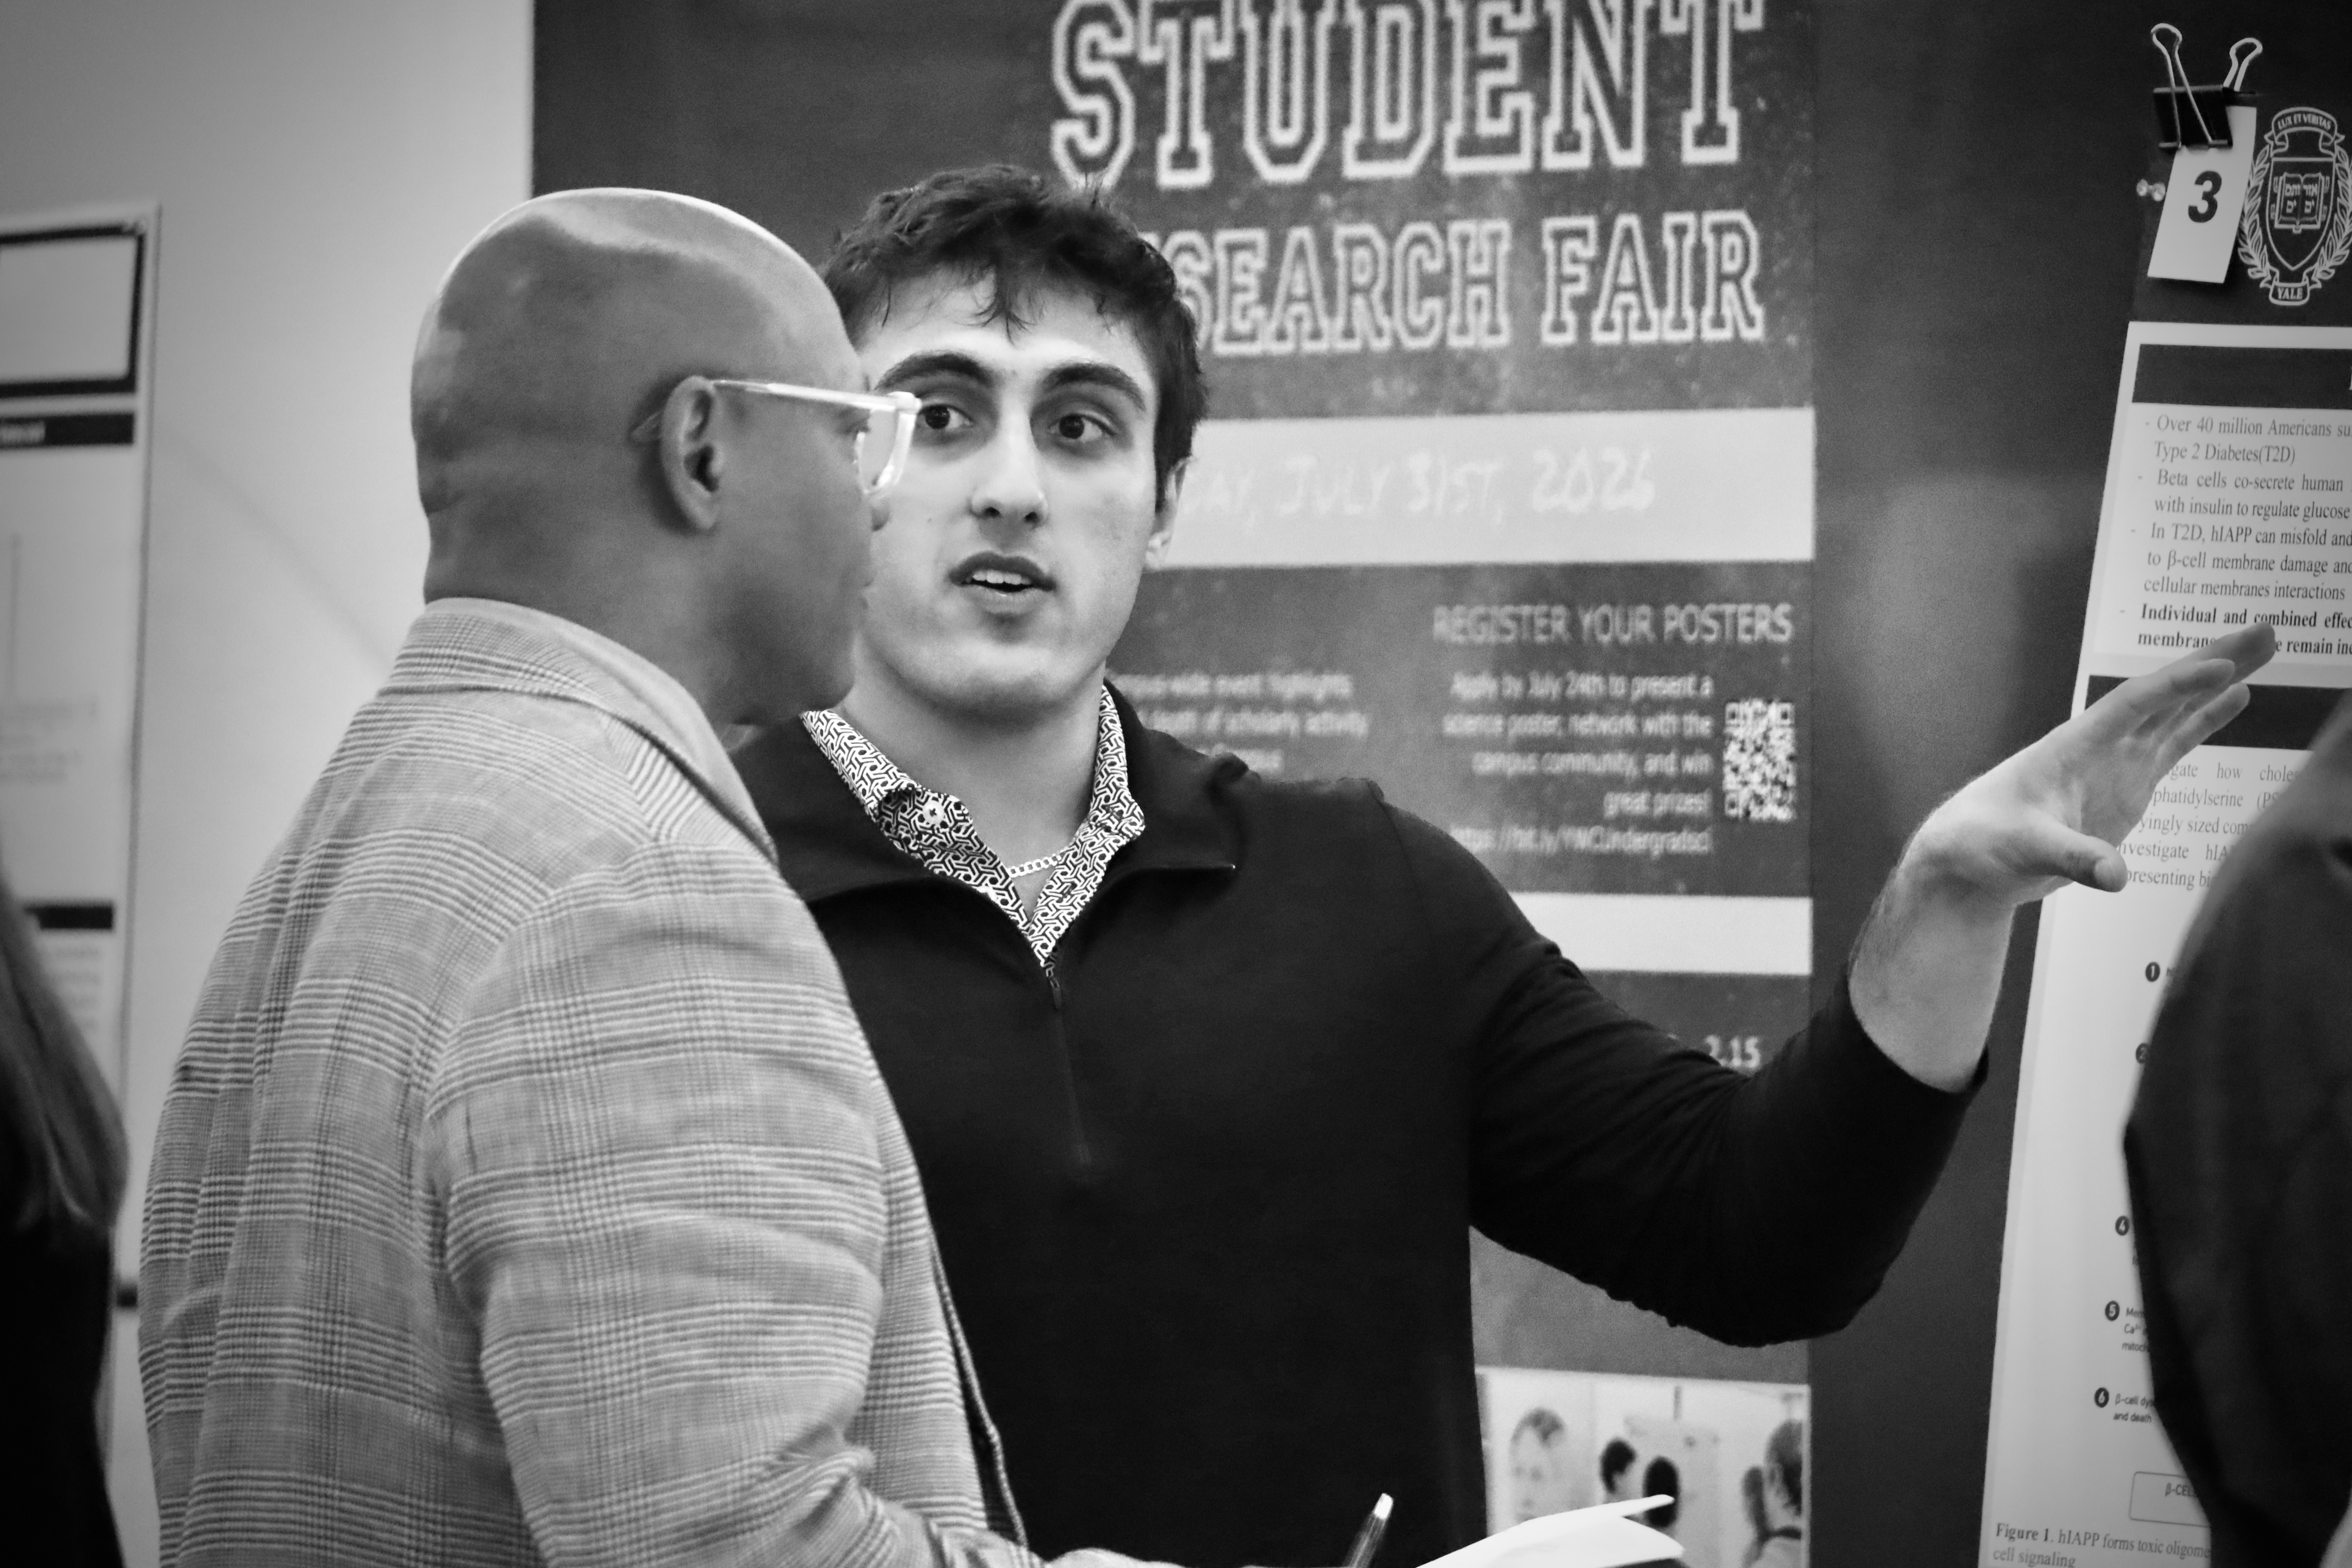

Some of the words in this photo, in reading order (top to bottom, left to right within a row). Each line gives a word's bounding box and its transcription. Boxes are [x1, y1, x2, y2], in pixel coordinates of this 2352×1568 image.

[1050, 0, 1764, 188] STUDENT
[2278, 116, 2292, 130] LUX
[2293, 114, 2301, 124] ET
[2303, 114, 2331, 130] VERITAS
[2188, 170, 2222, 223] 3
[1153, 219, 1509, 356] SEARCH
[1541, 210, 1765, 345] FAIR
[2278, 287, 2303, 300] YALE
[2157, 414, 2191, 433] Over
[2196, 416, 2214, 433] 40
[2218, 417, 2263, 435] million
[2267, 419, 2332, 437] Americans
[2154, 440, 2188, 464] Type
[2191, 443, 2200, 459] 2
[2204, 443, 2295, 466] Diabetes(T2D)
[1278, 452, 1393, 516] JULY
[1530, 444, 1656, 514] 2026
[2157, 468, 2188, 487] Beta
[2196, 470, 2227, 488] cells
[2234, 475, 2295, 490] co-secrete
[2301, 474, 2343, 492] human
[2154, 495, 2185, 513] with
[2190, 496, 2233, 515] insulin
[2237, 501, 2249, 516] to
[2252, 501, 2300, 522] regulate
[2303, 501, 2350, 522] glucose
[2151, 522, 2165, 539] In
[2172, 523, 2205, 544] T2D,
[2211, 525, 2252, 544] hIAPP
[2255, 531, 2275, 544] can
[2280, 527, 2327, 546] misfold
[2148, 551, 2161, 566] to
[2212, 553, 2275, 571] membrane
[2280, 555, 2328, 577] damage
[2144, 576, 2197, 594] cellular
[2201, 579, 2270, 597] membranes
[2274, 580, 2346, 601] interactions
[1433, 603, 1570, 643] REGISTER
[1580, 603, 1655, 643] YOUR
[1663, 602, 1792, 643] POSTERS
[2141, 603, 2217, 623] Individual
[2223, 608, 2248, 625] and
[2254, 609, 2317, 628] combined
[2286, 638, 2333, 654] remain
[1528, 671, 1562, 701] July
[1565, 671, 1606, 698] 24th
[1608, 675, 1628, 697] to
[1630, 675, 1697, 705] present
[1699, 676, 1714, 698] a
[1568, 711, 1637, 737] network
[1642, 710, 1681, 738] with
[1683, 710, 1713, 739] the
[1644, 749, 1678, 776] and
[1682, 750, 1713, 776] win
[2216, 761, 2243, 779] how
[1603, 791, 1651, 820] great
[2187, 815, 2219, 833] sized
[2118, 840, 2189, 862] nvestigate
[1996, 1522, 2038, 1542] Figure
[2043, 1528, 2054, 1543] 1.
[2058, 1529, 2099, 1547] hIAPP
[2102, 1533, 2135, 1551] forms
[2137, 1539, 2164, 1554] toxic
[1993, 1547, 2014, 1562] cell
[2018, 1550, 2076, 1568] signaling
